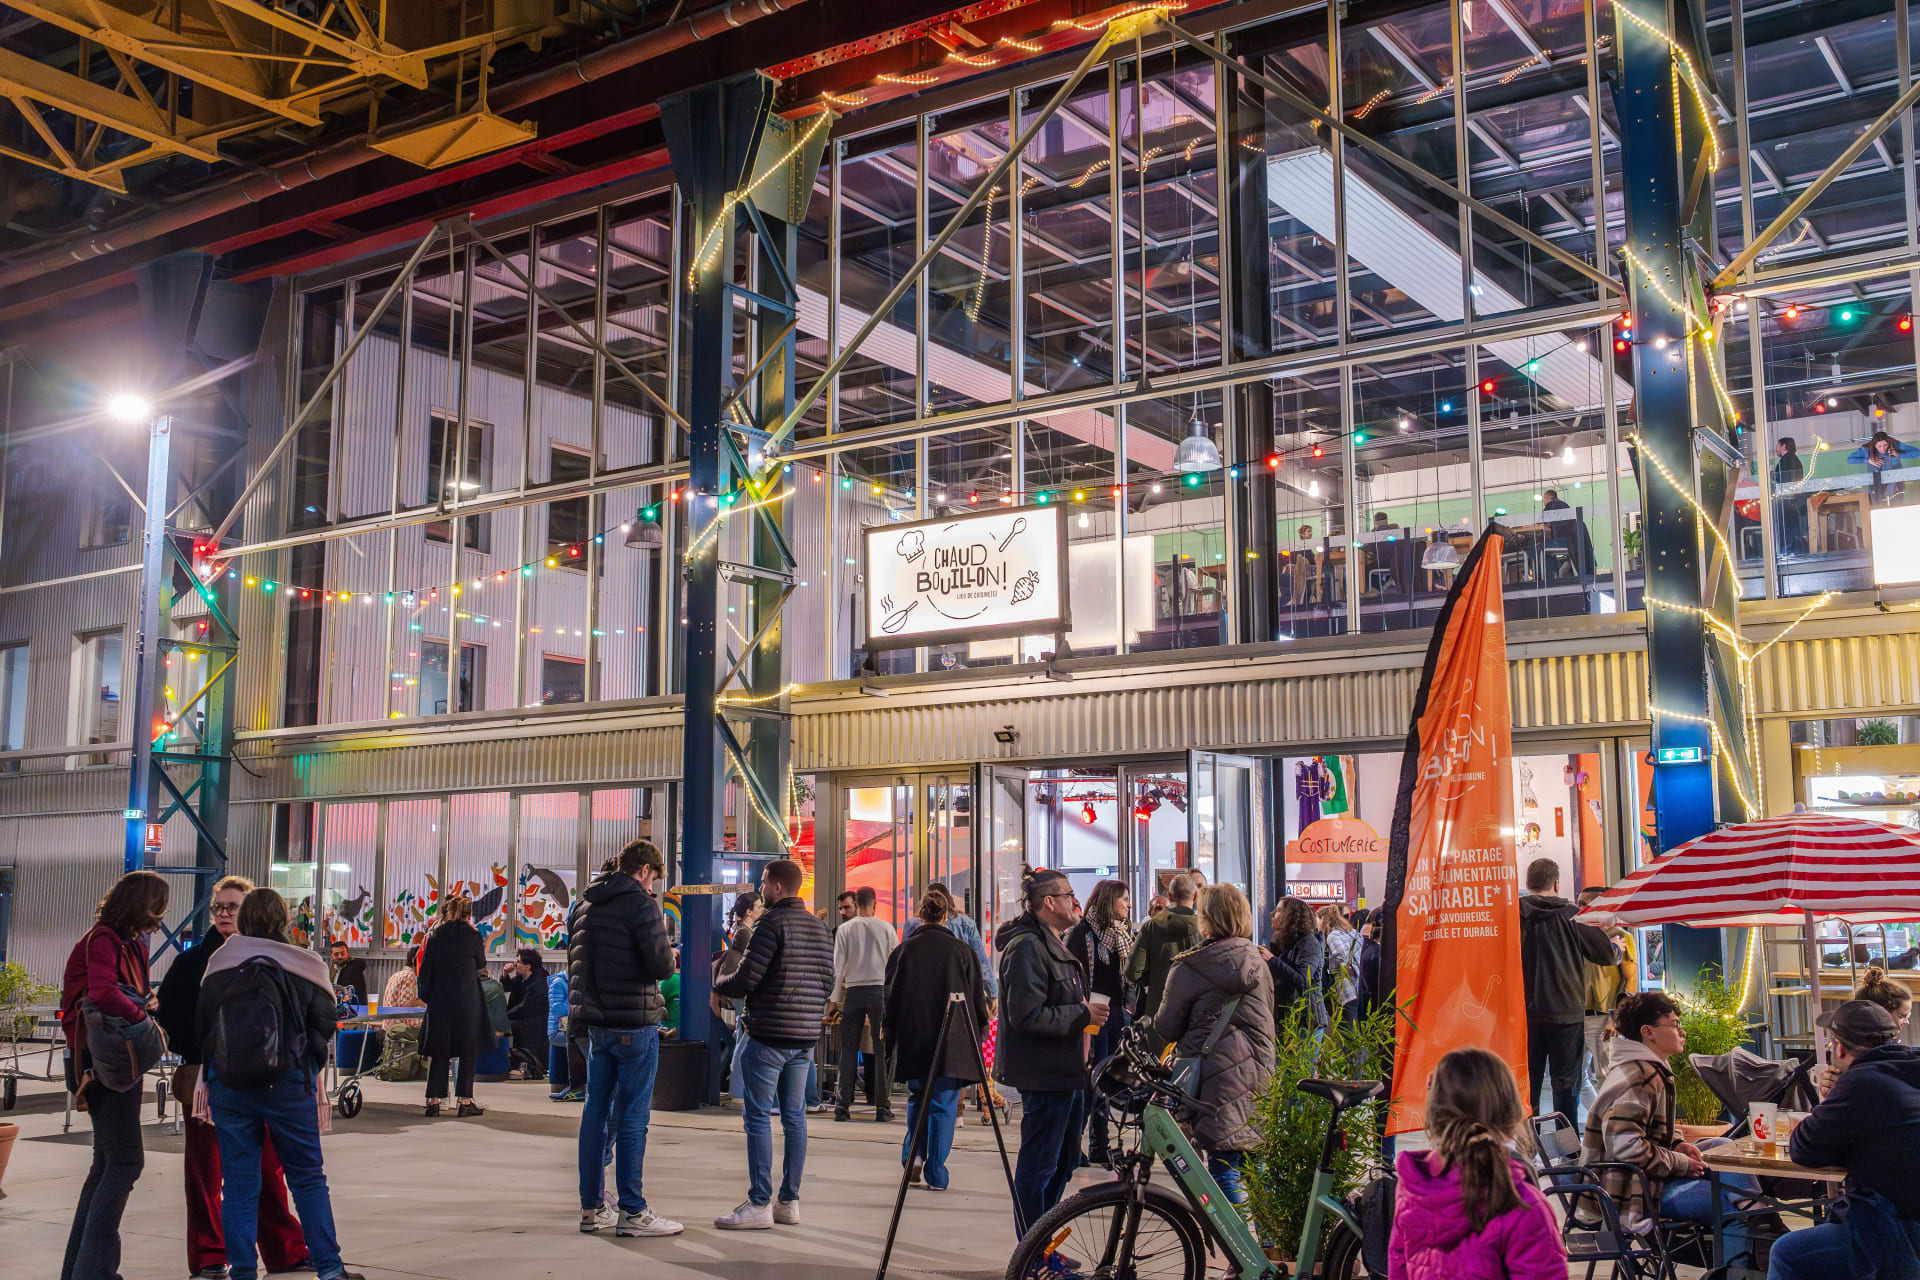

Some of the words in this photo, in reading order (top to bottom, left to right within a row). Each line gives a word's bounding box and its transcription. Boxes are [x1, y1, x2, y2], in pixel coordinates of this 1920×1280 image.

[934, 543, 987, 569] CHAUD
[916, 561, 1007, 595] BOUILLON!
[1300, 835, 1378, 854] COSTUMERIE
[1454, 847, 1503, 865] PARTAGE
[1409, 876, 1431, 892] OUR
[1440, 911, 1494, 924] SAVOUREUSE,
[1451, 927, 1461, 939] ET
[1463, 925, 1499, 938] DURABLE
